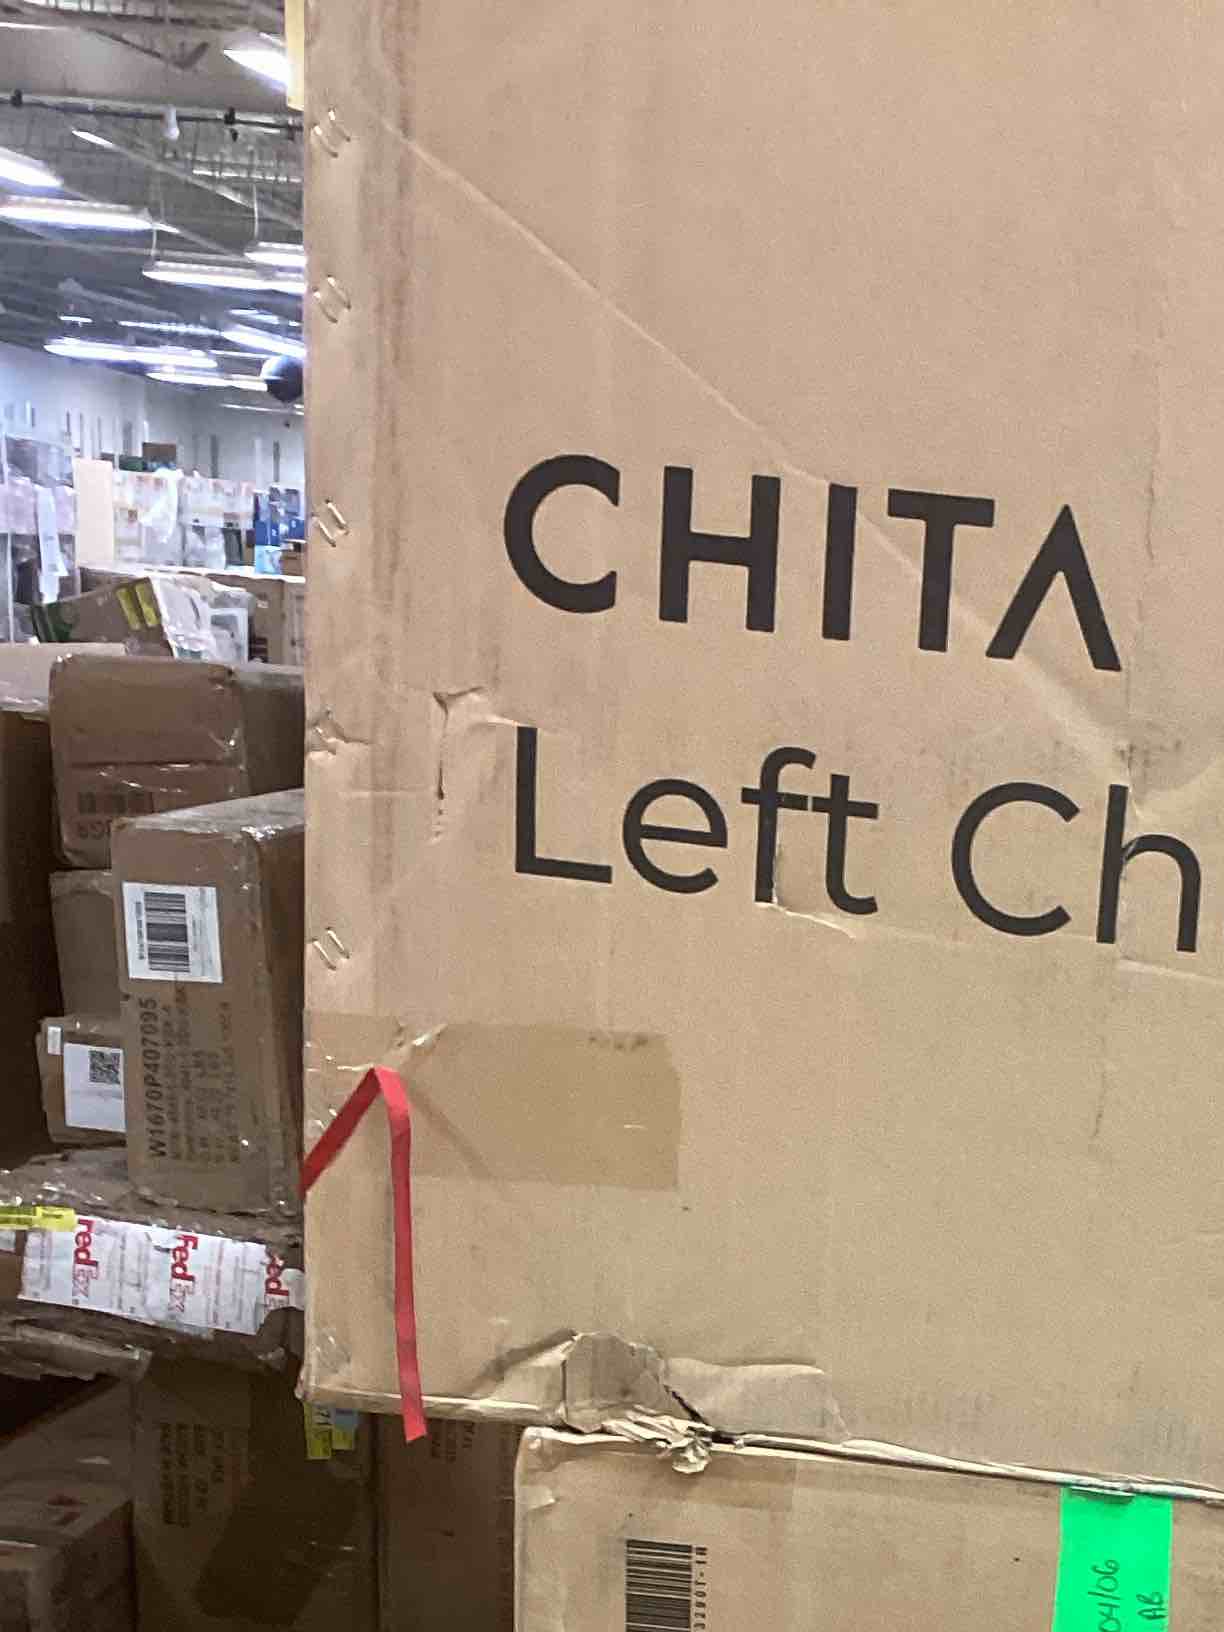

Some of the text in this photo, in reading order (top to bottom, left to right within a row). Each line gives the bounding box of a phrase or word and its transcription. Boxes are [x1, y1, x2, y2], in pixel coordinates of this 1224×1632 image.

[503, 453, 1121, 672] CHITA
[515, 726, 878, 916] Left
[168, 1234, 200, 1313] FedEx
